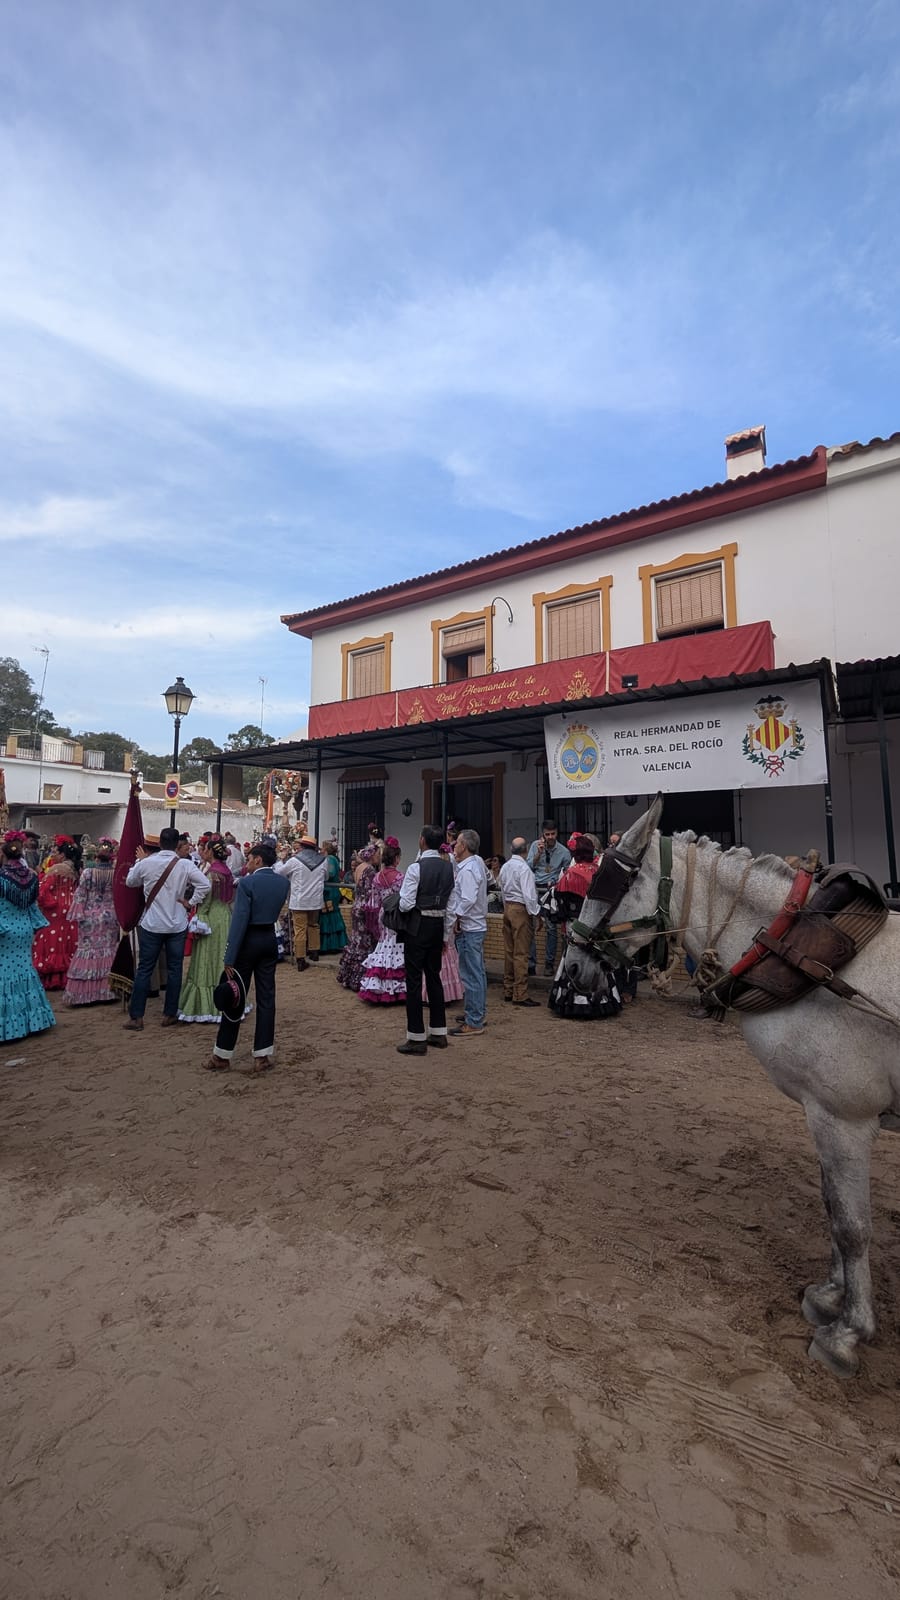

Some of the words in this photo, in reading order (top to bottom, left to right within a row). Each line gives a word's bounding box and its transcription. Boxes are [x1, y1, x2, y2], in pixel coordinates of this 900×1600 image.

[436, 691, 457, 704] Real
[462, 678, 517, 697] Hermandad
[524, 674, 536, 685] de
[489, 695, 502, 705] del
[538, 686, 550, 696] de
[614, 730, 638, 740] REAL
[641, 721, 704, 737] HERMANDAD
[707, 719, 721, 729] DE
[613, 747, 642, 757] NTRA.
[644, 745, 667, 755] SRA.
[669, 742, 689, 752] DEL
[691, 737, 723, 750] ROCÍO
[642, 760, 692, 773] VALENCIA
[565, 781, 592, 791] Valencia
